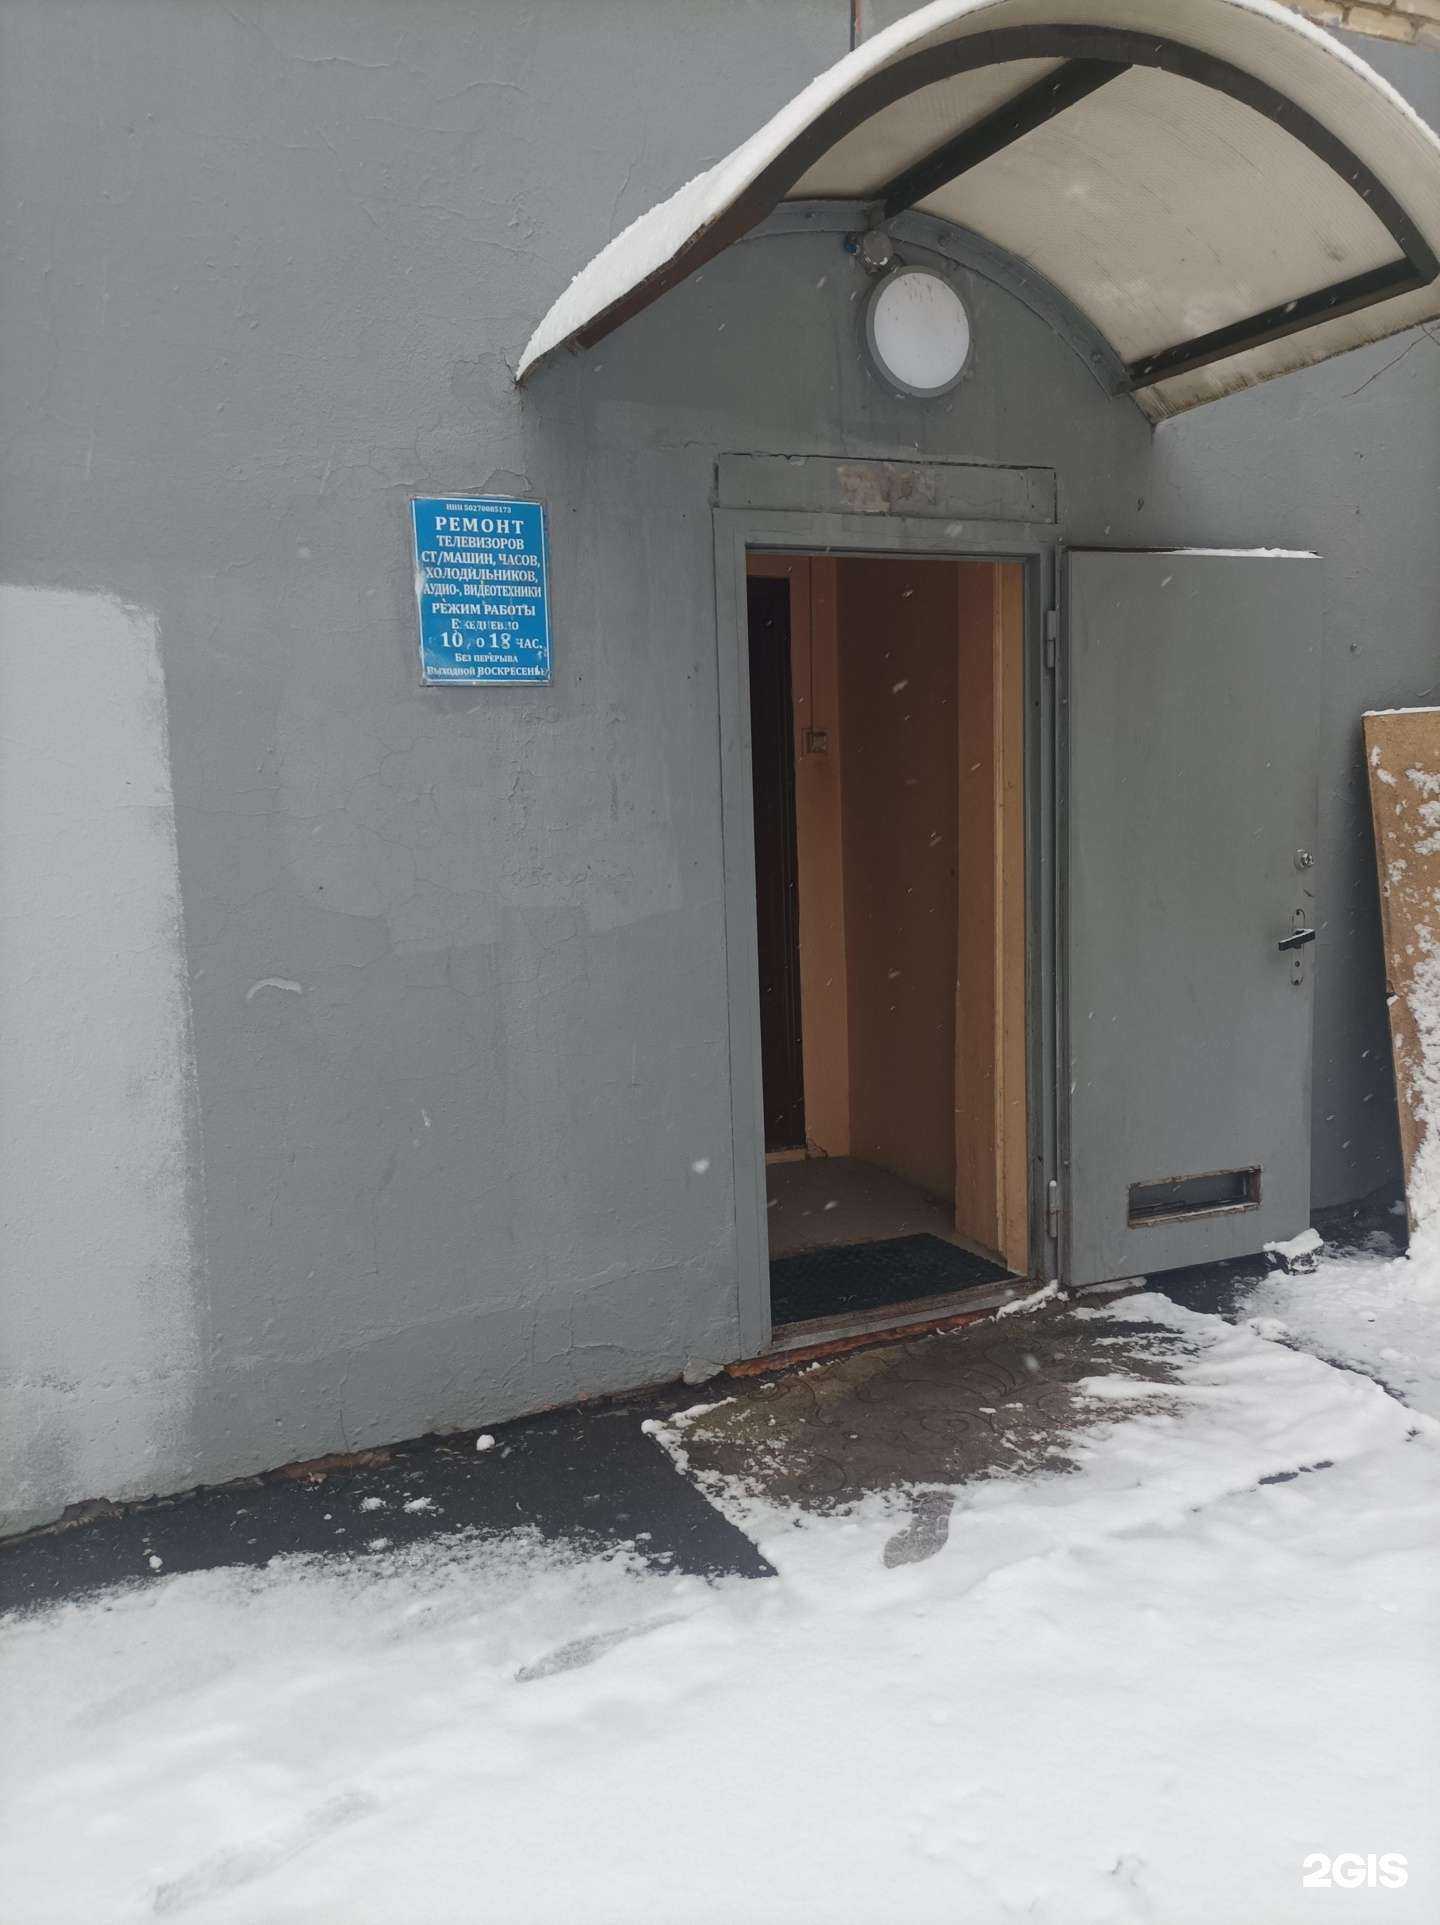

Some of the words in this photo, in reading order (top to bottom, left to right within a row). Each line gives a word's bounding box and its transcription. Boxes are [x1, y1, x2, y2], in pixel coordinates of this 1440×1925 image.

[435, 516, 525, 534] РЕМОНТ
[436, 534, 525, 550] ТЕЛЕВИЗОРОВ
[421, 551, 497, 566] СТ/МАШИН,
[498, 553, 540, 568] ЧАСОВ,
[425, 567, 538, 583] ХОЛОДИЛЬНИКОВ,
[464, 584, 542, 598] ВИДЕОТЕХНИКИ
[432, 602, 481, 615] РЕЖИМ
[484, 604, 536, 616] РАБОТЫ
[440, 632, 464, 648] 10
[489, 632, 512, 649] 18
